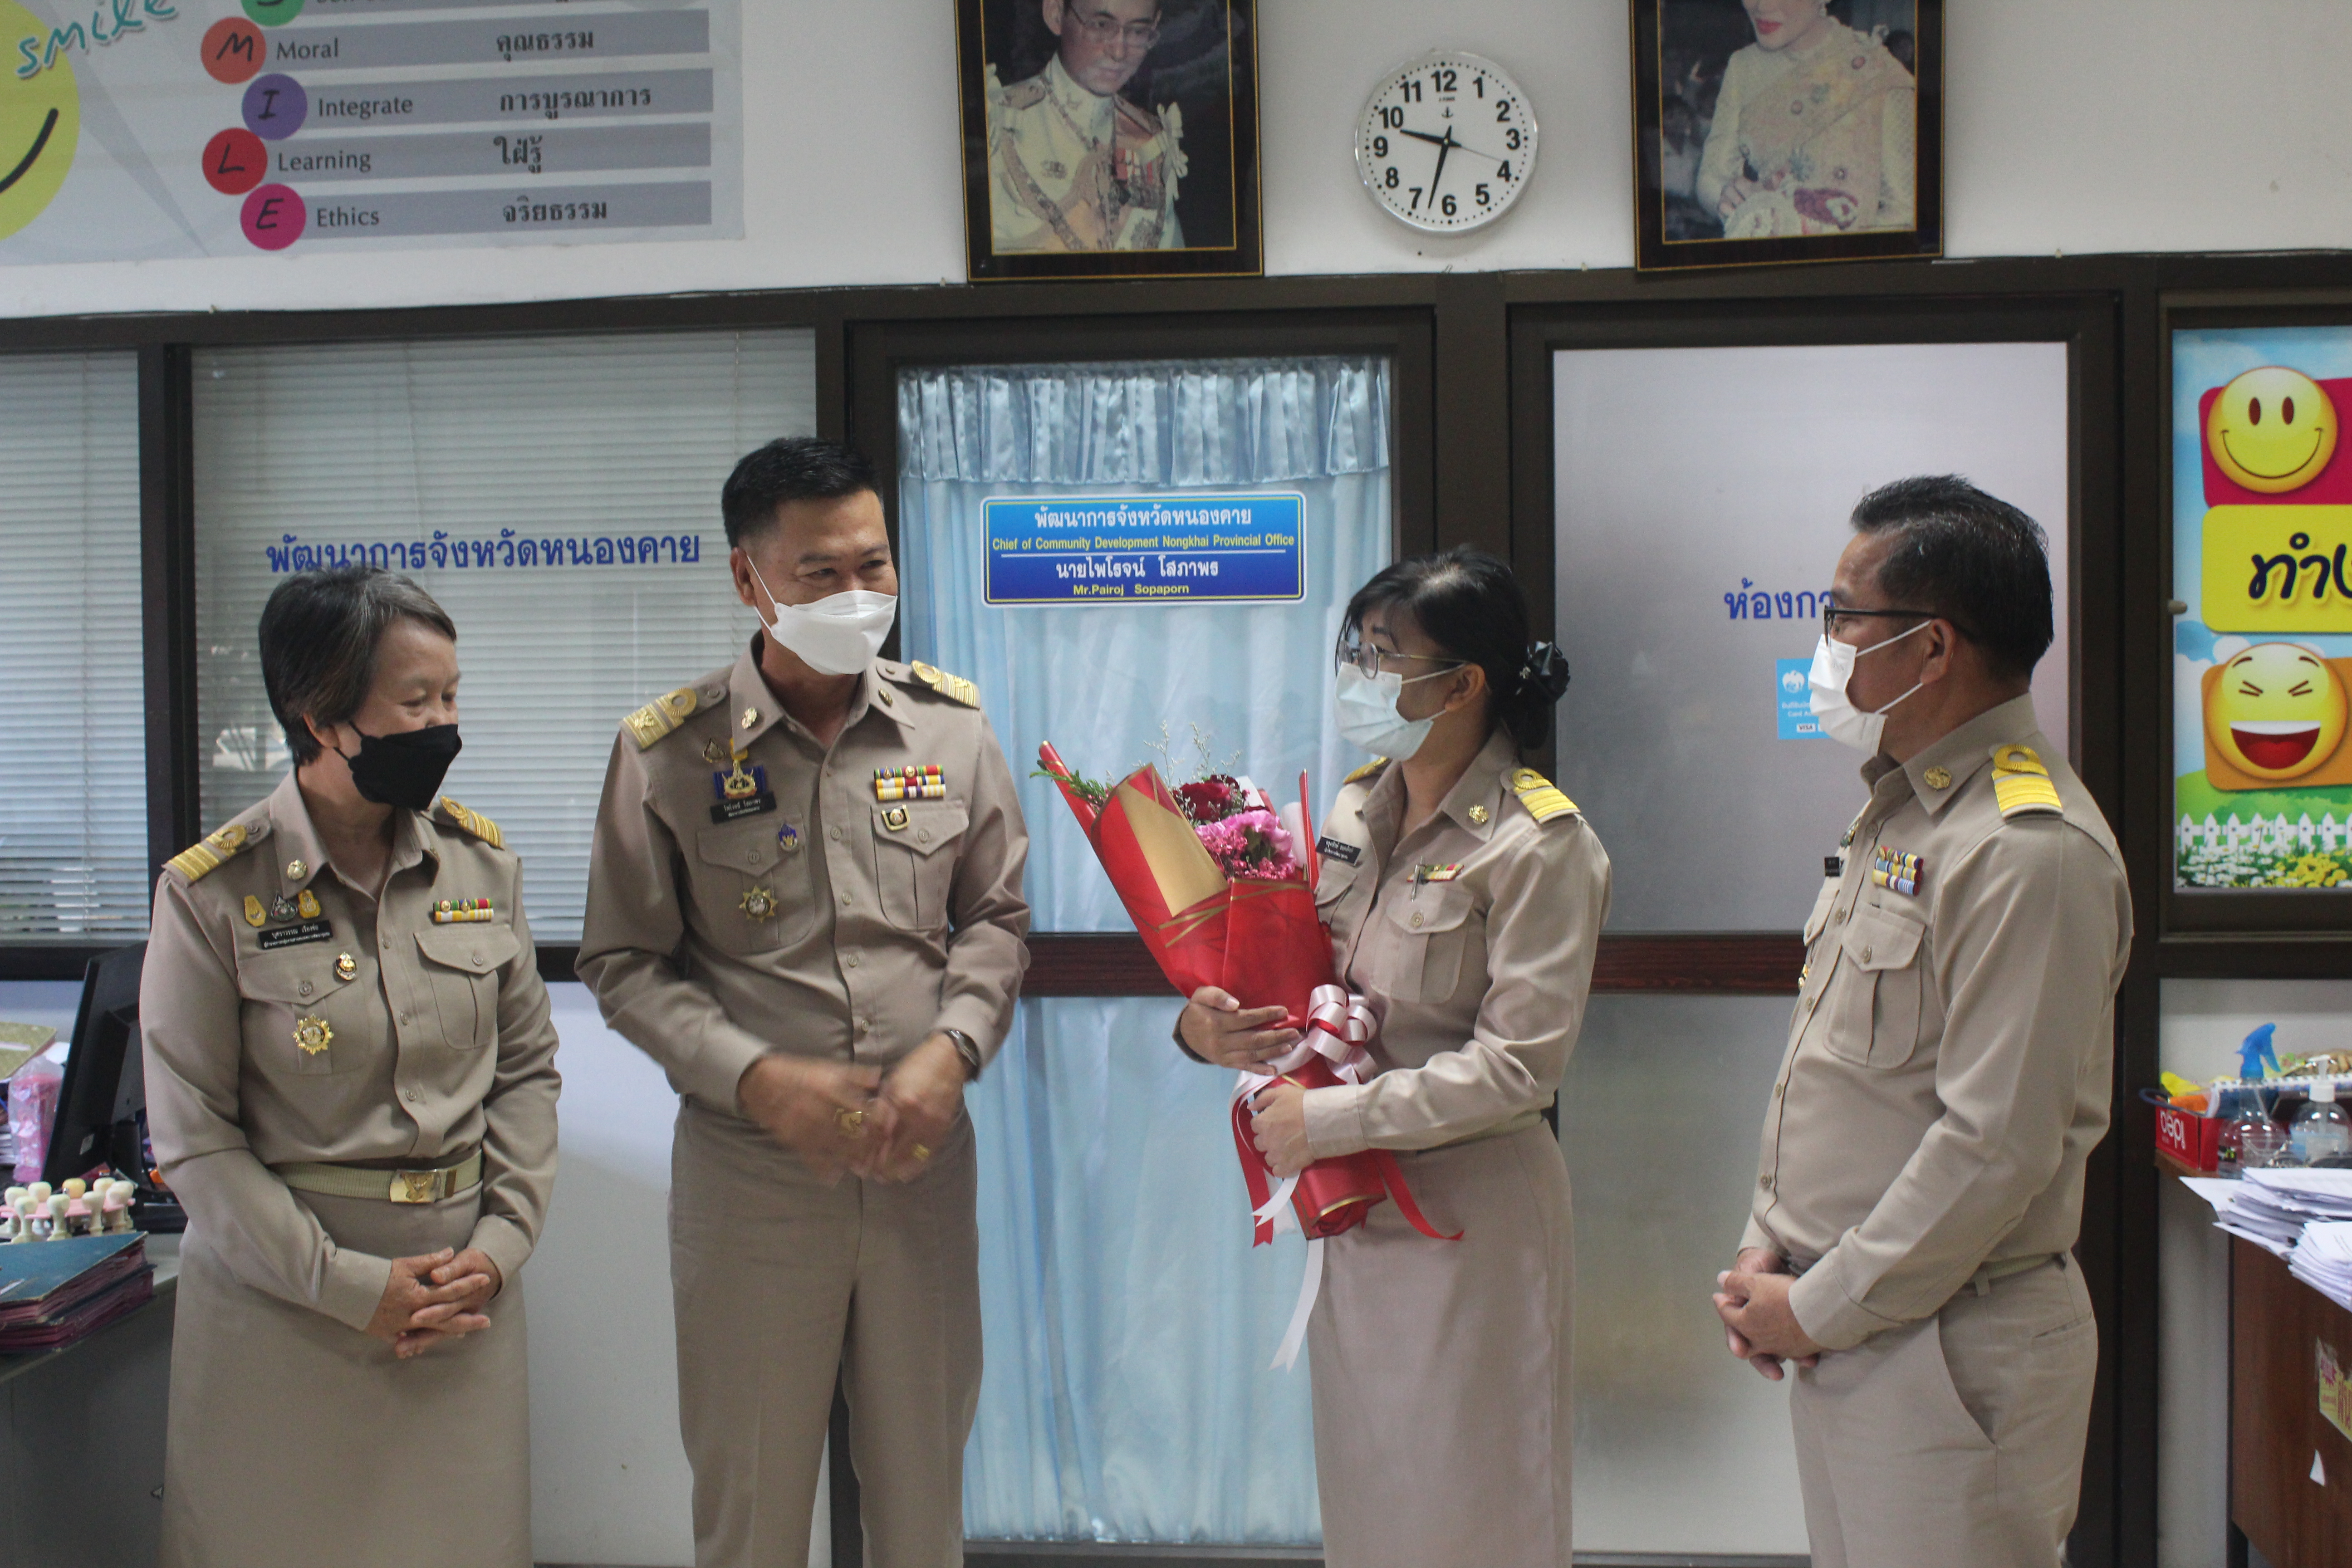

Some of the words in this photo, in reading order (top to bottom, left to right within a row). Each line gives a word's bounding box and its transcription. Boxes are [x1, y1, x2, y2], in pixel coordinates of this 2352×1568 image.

[217, 32, 253, 62] M
[276, 36, 338, 60] Moral
[496, 31, 593, 62] คุณธรรม
[1400, 80, 1421, 103] 11
[1431, 69, 1457, 92] 12
[1473, 77, 1483, 98] 1
[258, 89, 279, 119] I
[319, 96, 413, 120] Integrate
[500, 88, 651, 120] การบูรณาการ
[1496, 99, 1510, 122] 2
[1378, 106, 1404, 129] 10
[1373, 136, 1388, 157] 9
[1506, 128, 1521, 150] 3
[218, 143, 245, 174] L
[278, 150, 371, 173] Learning
[493, 135, 543, 173] ใฝ่รู้
[1385, 167, 1399, 188] 8
[1497, 160, 1511, 182] 4
[1409, 187, 1422, 209] 7
[1441, 194, 1456, 216] 6
[1475, 183, 1490, 205] 5
[256, 198, 284, 230] E
[317, 206, 380, 227] Ethics
[503, 195, 607, 222] จริยธรรม
[1034, 503, 1251, 528] พัฒนาการจังหวัดหนองคาย
[266, 528, 700, 573] พัฒนาการจังหวัดหนองคาย
[993, 537, 1018, 550] Chief
[1022, 538, 1032, 550] of
[1035, 537, 1090, 552] Community
[1094, 536, 1159, 551] Development
[1162, 534, 1209, 550] Nongkhai
[1213, 533, 1261, 547] Provincial
[1265, 533, 1294, 546] Office
[1056, 555, 1146, 578] นายไพโรจน์
[1158, 554, 1219, 577] โสภาพร
[1073, 583, 1124, 596] Mr.Pairoj
[1134, 583, 1190, 596] Sopaporn
